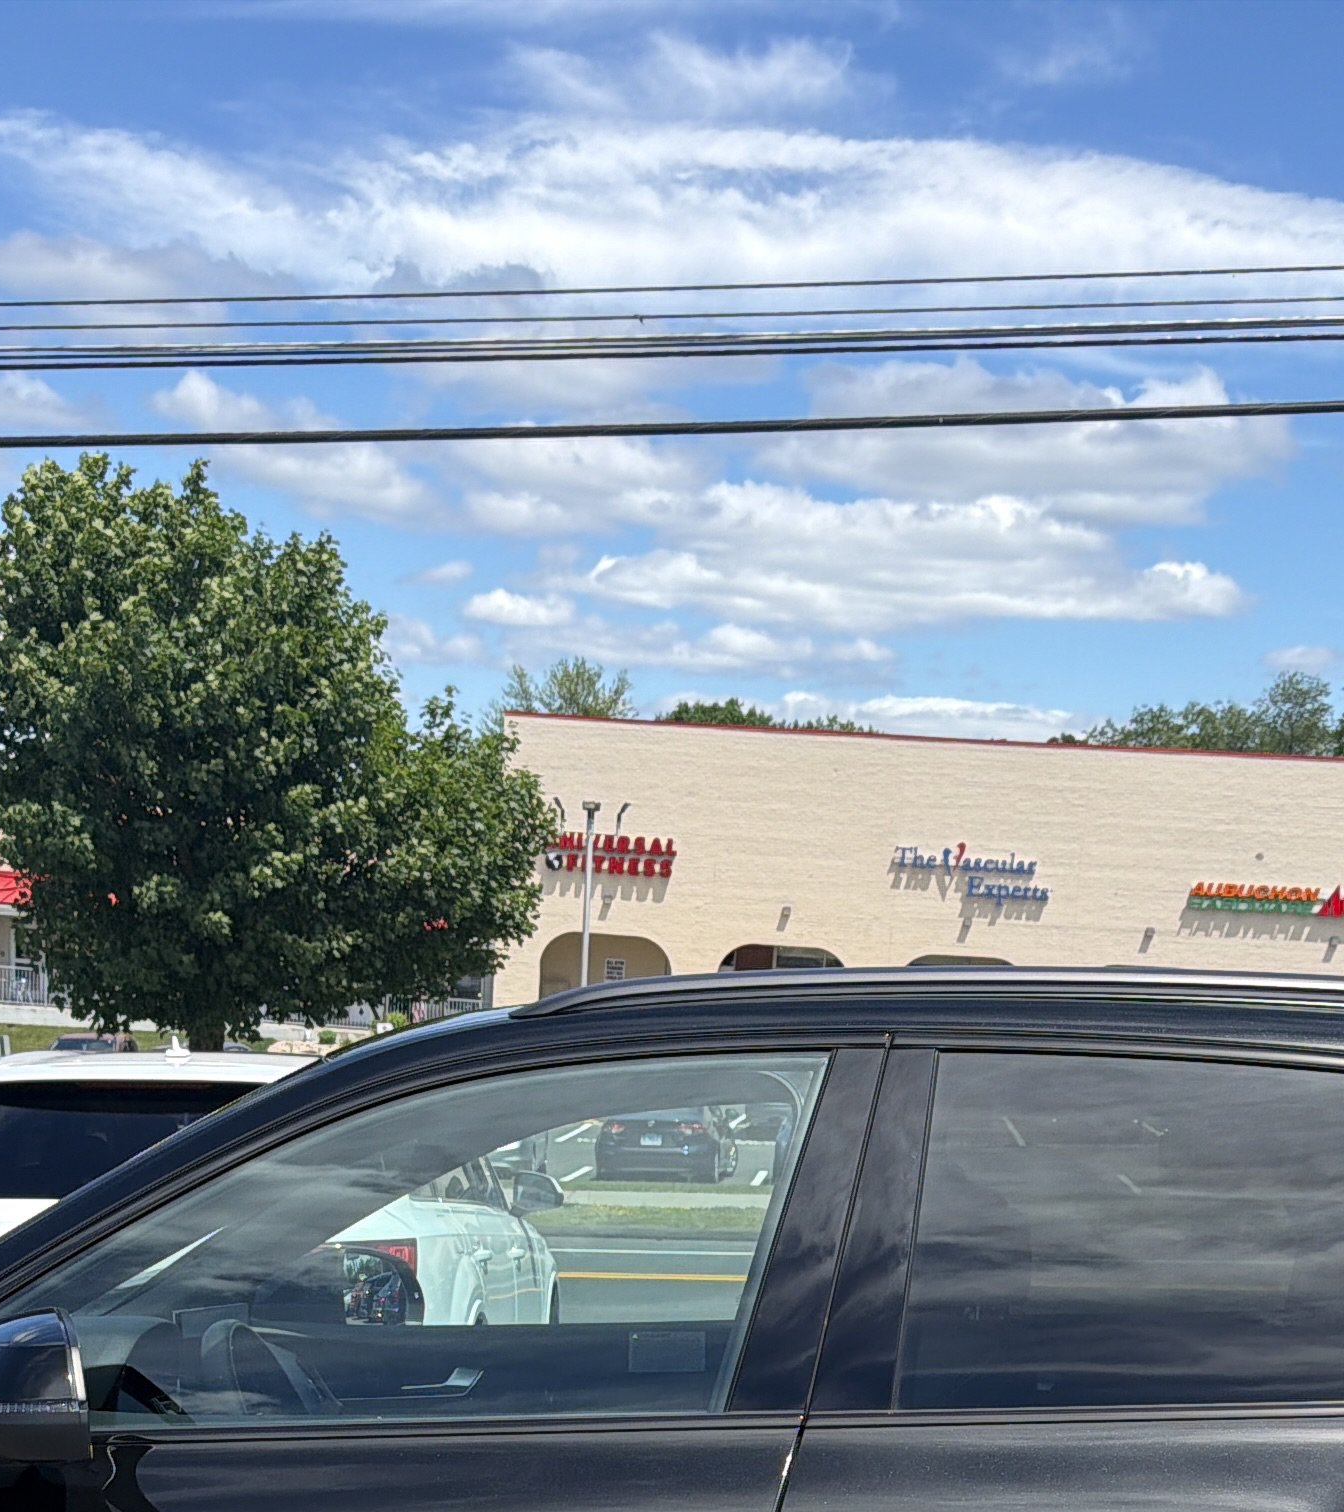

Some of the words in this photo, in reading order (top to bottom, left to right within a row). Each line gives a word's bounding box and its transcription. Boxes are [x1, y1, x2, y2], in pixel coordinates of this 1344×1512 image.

[548, 831, 677, 857] NIVERSAL
[566, 854, 673, 878] FITNESS
[895, 845, 938, 869] The
[943, 841, 1038, 876] Vascular
[966, 875, 1050, 908] Experts
[1190, 881, 1321, 902] AUBUCHON
